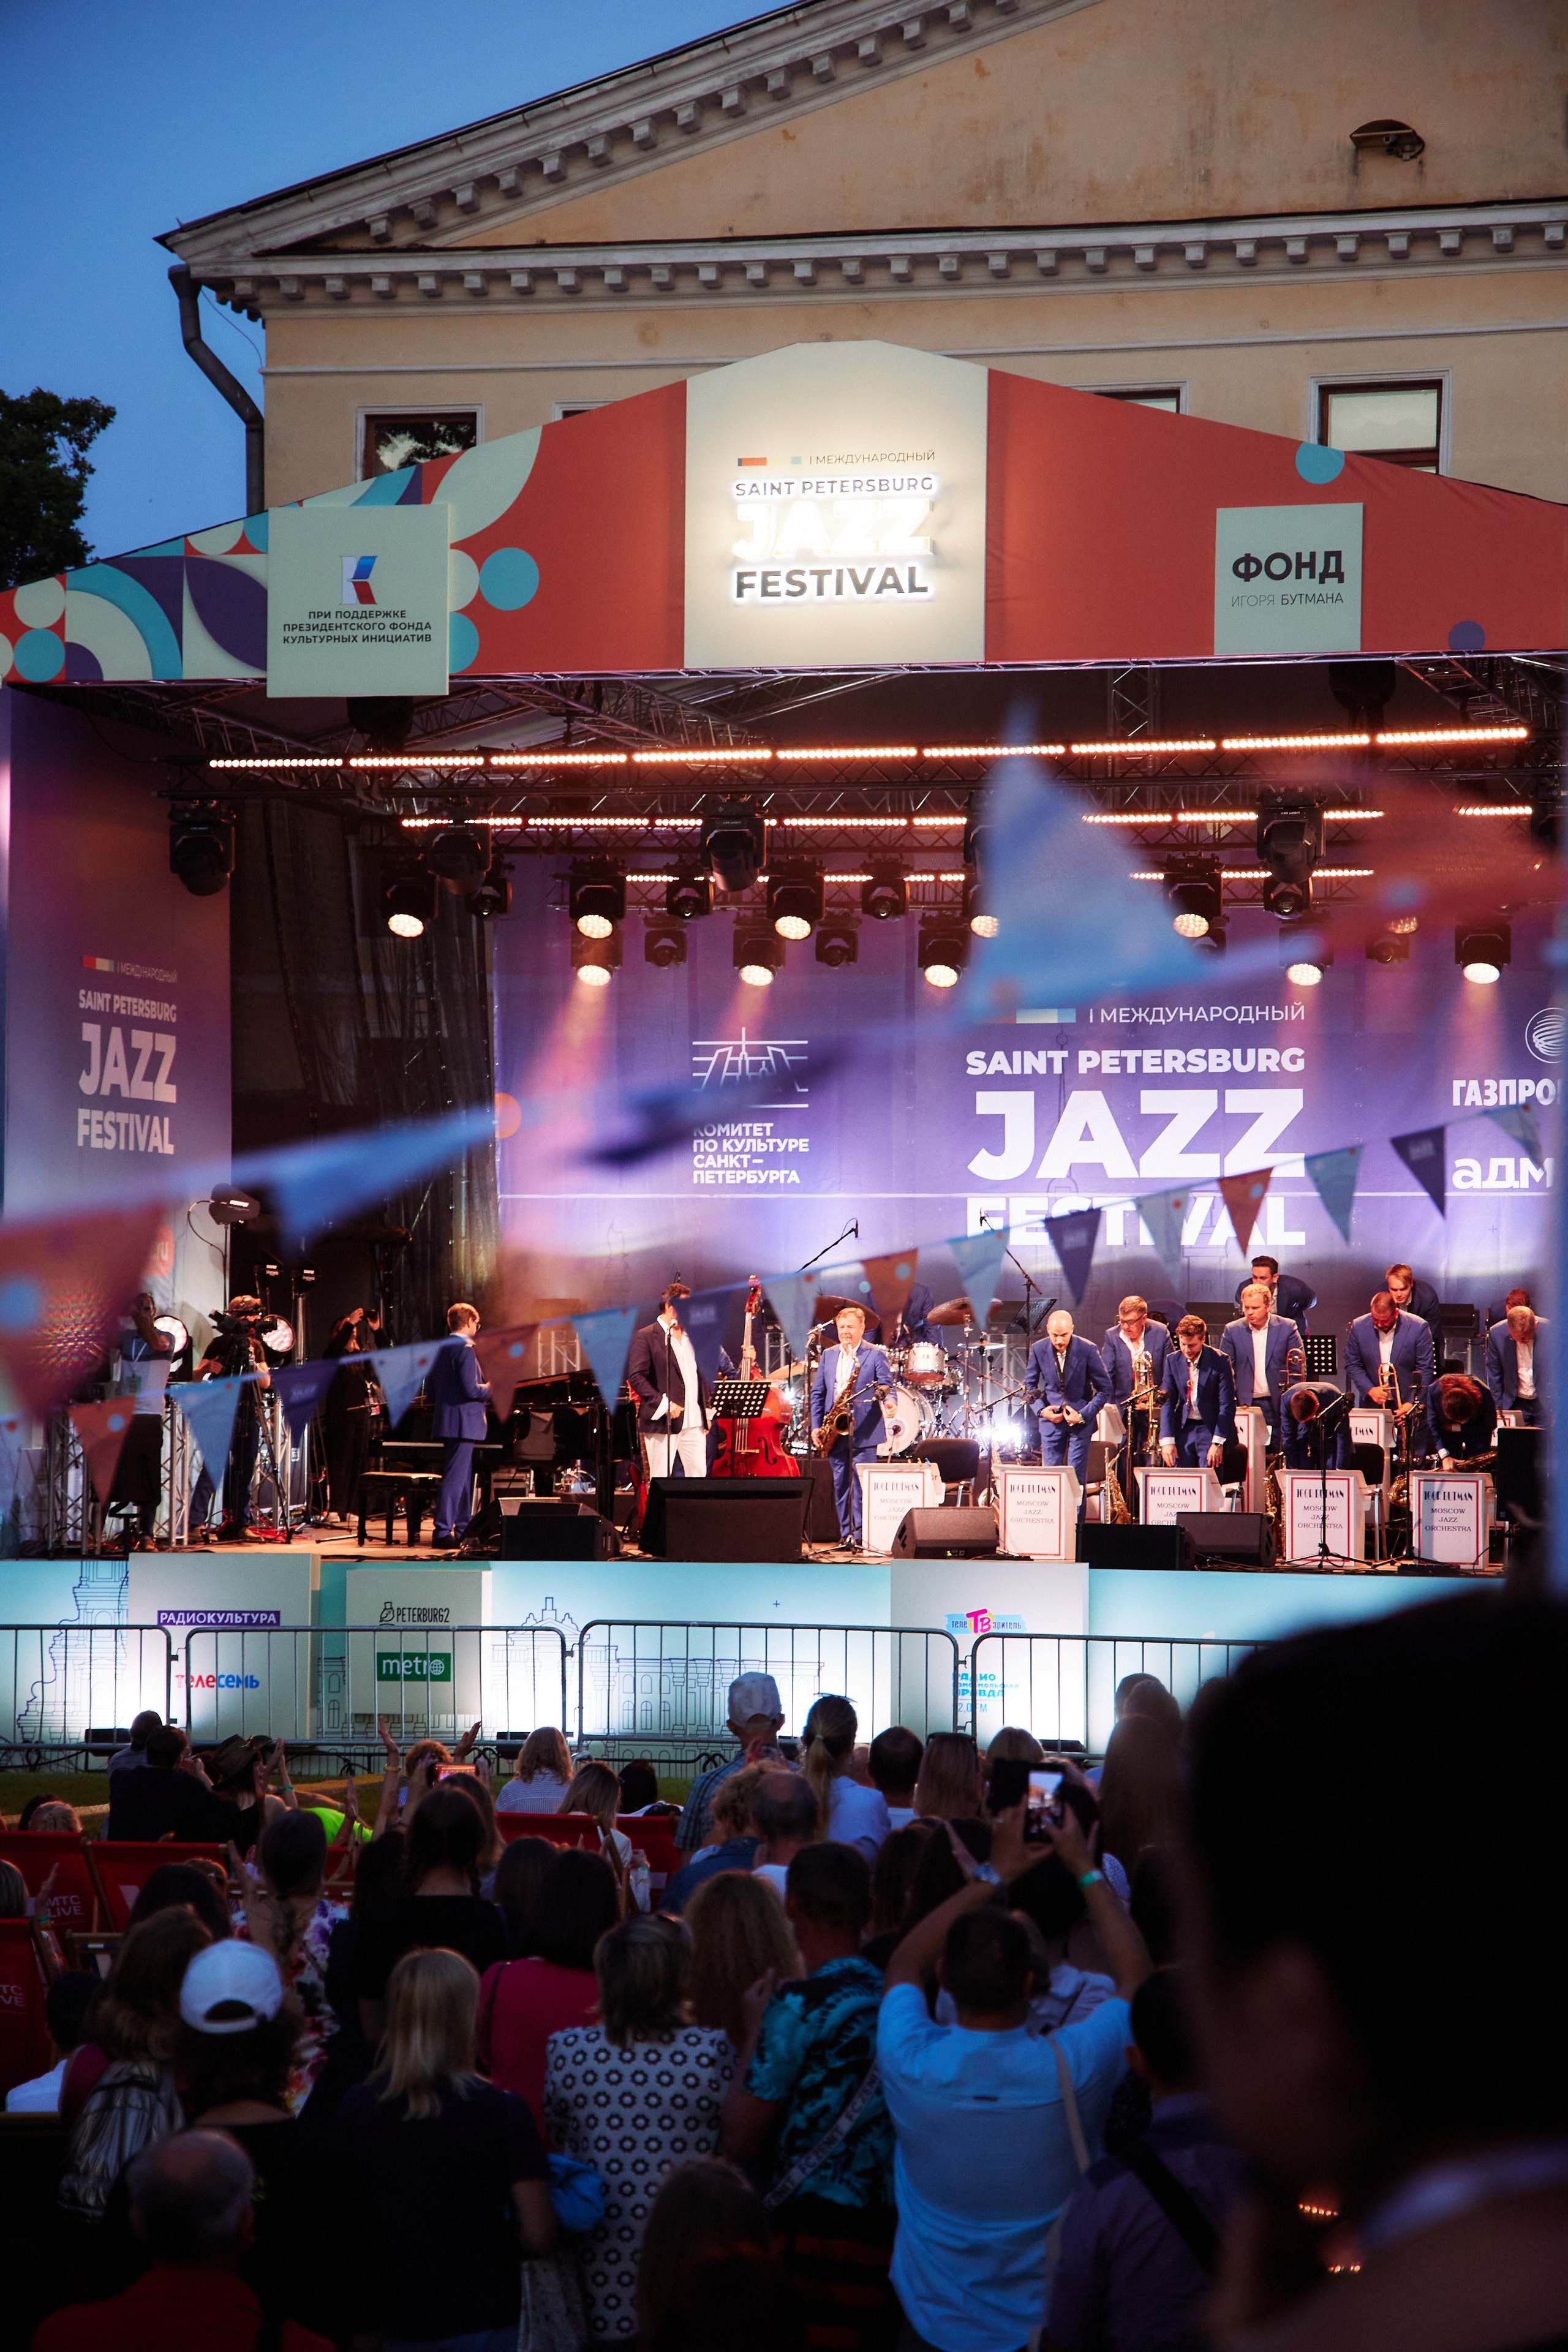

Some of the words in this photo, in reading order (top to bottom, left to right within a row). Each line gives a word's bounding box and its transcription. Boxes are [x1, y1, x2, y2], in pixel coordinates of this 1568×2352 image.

[816, 450, 935, 465] МЕЖДУНАРОДНЫЙ
[736, 481, 795, 496] SAINT
[802, 477, 933, 494] PETERSBURG
[731, 498, 933, 560] JAZZ
[1232, 550, 1344, 584] ФОНД
[736, 567, 929, 598] FESTIVAL
[1232, 594, 1275, 607] ИГОРЯ
[1281, 592, 1344, 606] БУТМАНА
[308, 611, 331, 619] ПРИ
[335, 610, 406, 620] ПОДДЕРЖКЕ
[283, 622, 386, 632] ПРЕЗИДЕНТСКОГО
[389, 622, 432, 631] ФОНДА
[283, 635, 358, 644] КУЛЬТУРНЫХ
[362, 634, 431, 644] ИНИЦИАТИВ
[121, 963, 178, 984] МЕЖДУНАРОДНЫЙ
[79, 989, 110, 1014] SAINT
[113, 994, 177, 1023] PETERSBURG
[1101, 1002, 1305, 1025] МЕЖДУНАРОДНЫЙ
[78, 1022, 177, 1103] JAZZ
[966, 1050, 1068, 1076] SAINT
[1078, 1047, 1305, 1074] PETERSBURG
[1452, 1079, 1561, 1106] ГАЗПРО
[78, 1108, 175, 1155] FESTIVAL
[967, 1088, 1305, 1181] JAZZ
[693, 1139, 718, 1153] ПО
[722, 1139, 810, 1153] КУЛЬТУРЕ
[693, 1169, 801, 1184] ПЕТЕРБУРГА
[160, 1613, 276, 1625] РАДИОКУЛЬТУРА
[396, 1607, 450, 1623] PETERBURG2
[382, 1656, 445, 1675] metro
[47, 1905, 83, 1918] LIVE
